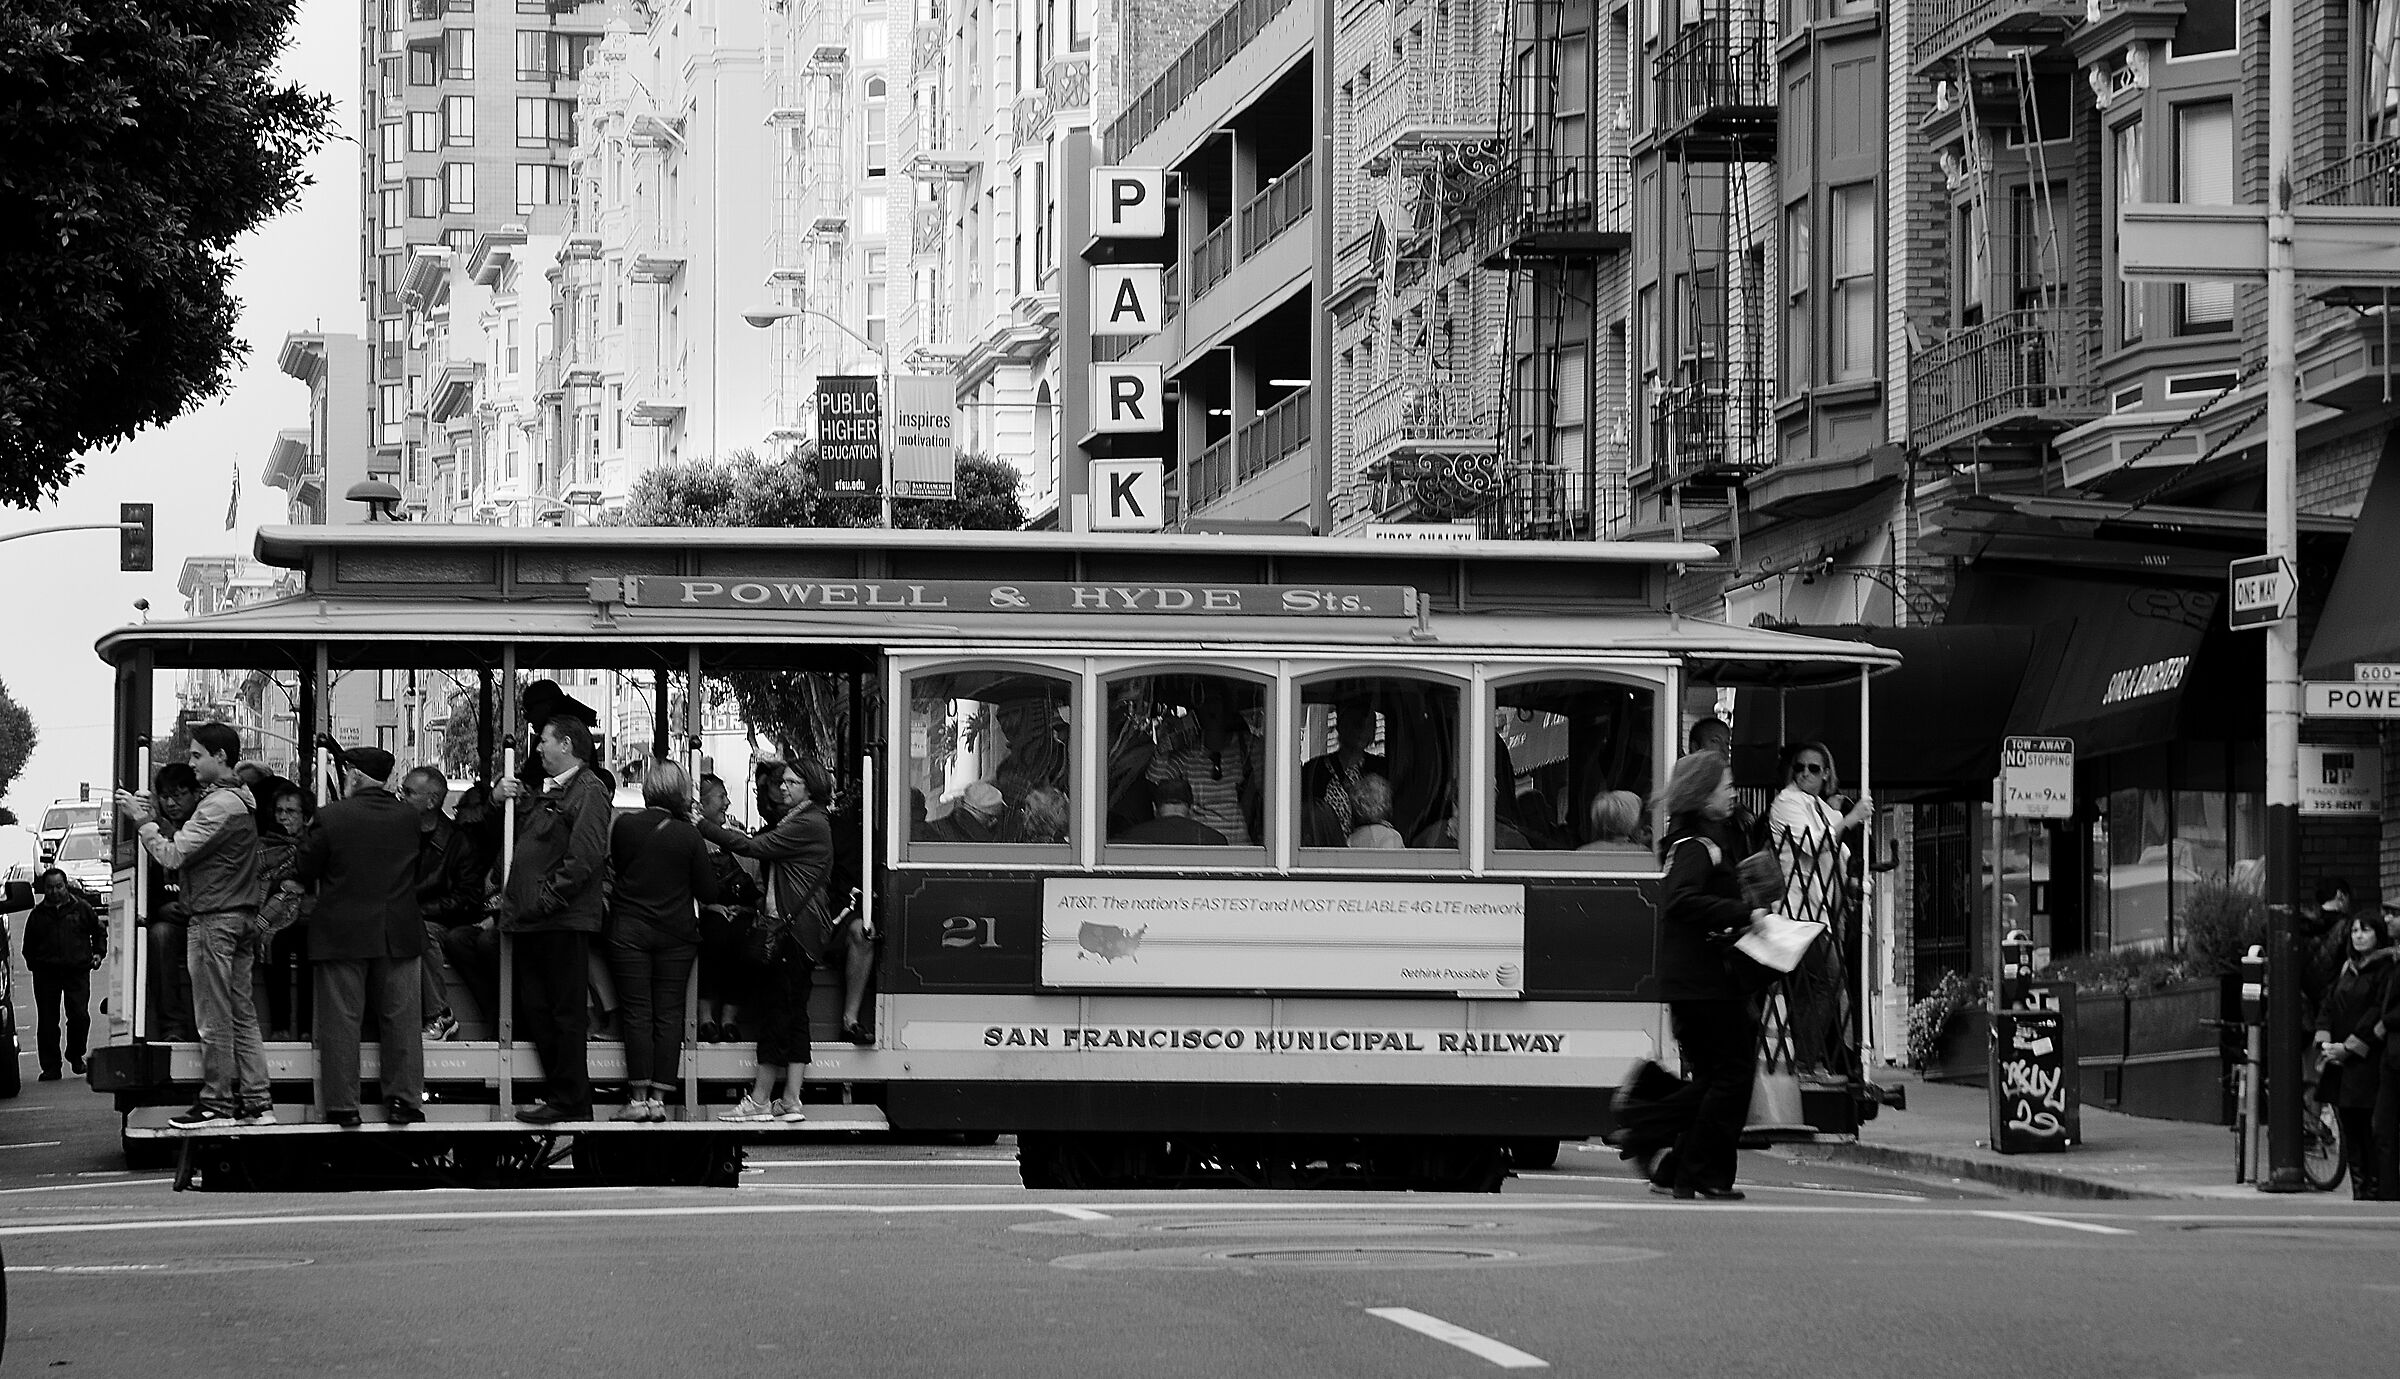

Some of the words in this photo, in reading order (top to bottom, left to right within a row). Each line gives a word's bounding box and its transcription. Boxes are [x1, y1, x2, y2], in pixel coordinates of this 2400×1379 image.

[820, 392, 877, 415] PUBLIC
[821, 419, 877, 441] HIGHER
[899, 410, 951, 431] inspires
[898, 433, 951, 447] motivation
[821, 444, 878, 460] EDUCATION
[835, 479, 866, 491] sfsu.edu
[679, 582, 948, 607] POWELL
[989, 586, 1031, 608] &
[1071, 587, 1241, 611] HYDE
[1281, 589, 1372, 612] Sts.
[2237, 581, 2256, 605] ONE
[2259, 577, 2278, 602] WAY
[2006, 749, 2026, 767] NO
[2027, 754, 2070, 767] STOPPING
[1102, 896, 1129, 910] The
[1131, 896, 1190, 911] nation's
[1191, 898, 1258, 912] FASTEST
[1259, 898, 1288, 912] and
[1291, 899, 1336, 913] MOST
[1337, 899, 1407, 913] RELIABLE
[1410, 900, 1433, 914] 4G
[1435, 901, 1462, 914] LTE
[942, 917, 1002, 948] 21
[1401, 967, 1441, 979] Rethink
[1444, 968, 1490, 980] Possible
[983, 1026, 1050, 1047] SAN
[1063, 1028, 1245, 1050] FRANCISCO
[1254, 1030, 1425, 1052] MUNICIPAL
[1438, 1032, 1567, 1054] RAILWAY
